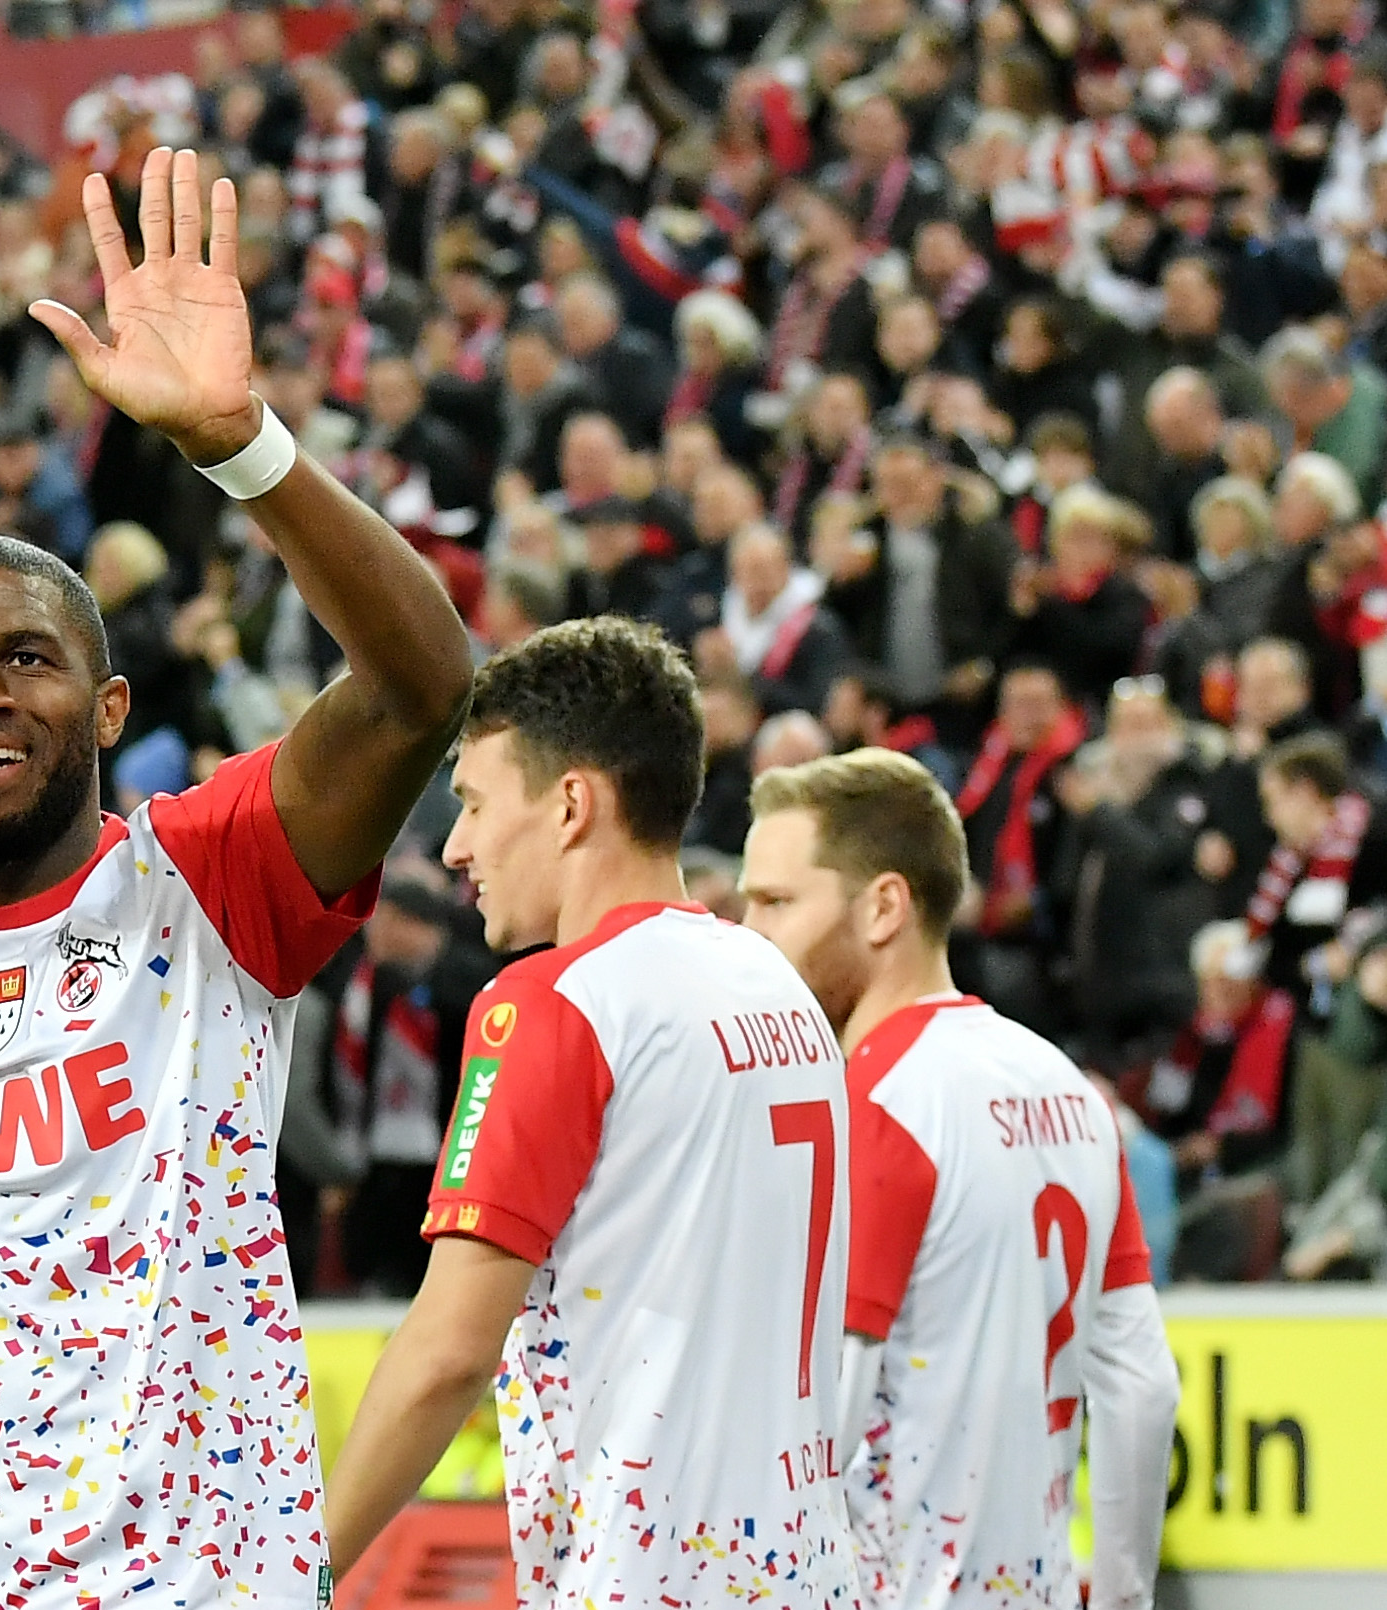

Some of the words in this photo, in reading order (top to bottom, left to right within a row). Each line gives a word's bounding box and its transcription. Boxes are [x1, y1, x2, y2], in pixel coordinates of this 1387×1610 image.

[450, 1071, 497, 1178] DEVK
[711, 1008, 838, 1073] LJUBICI
[770, 1100, 834, 1400] 7
[1034, 1183, 1088, 1435] 2
